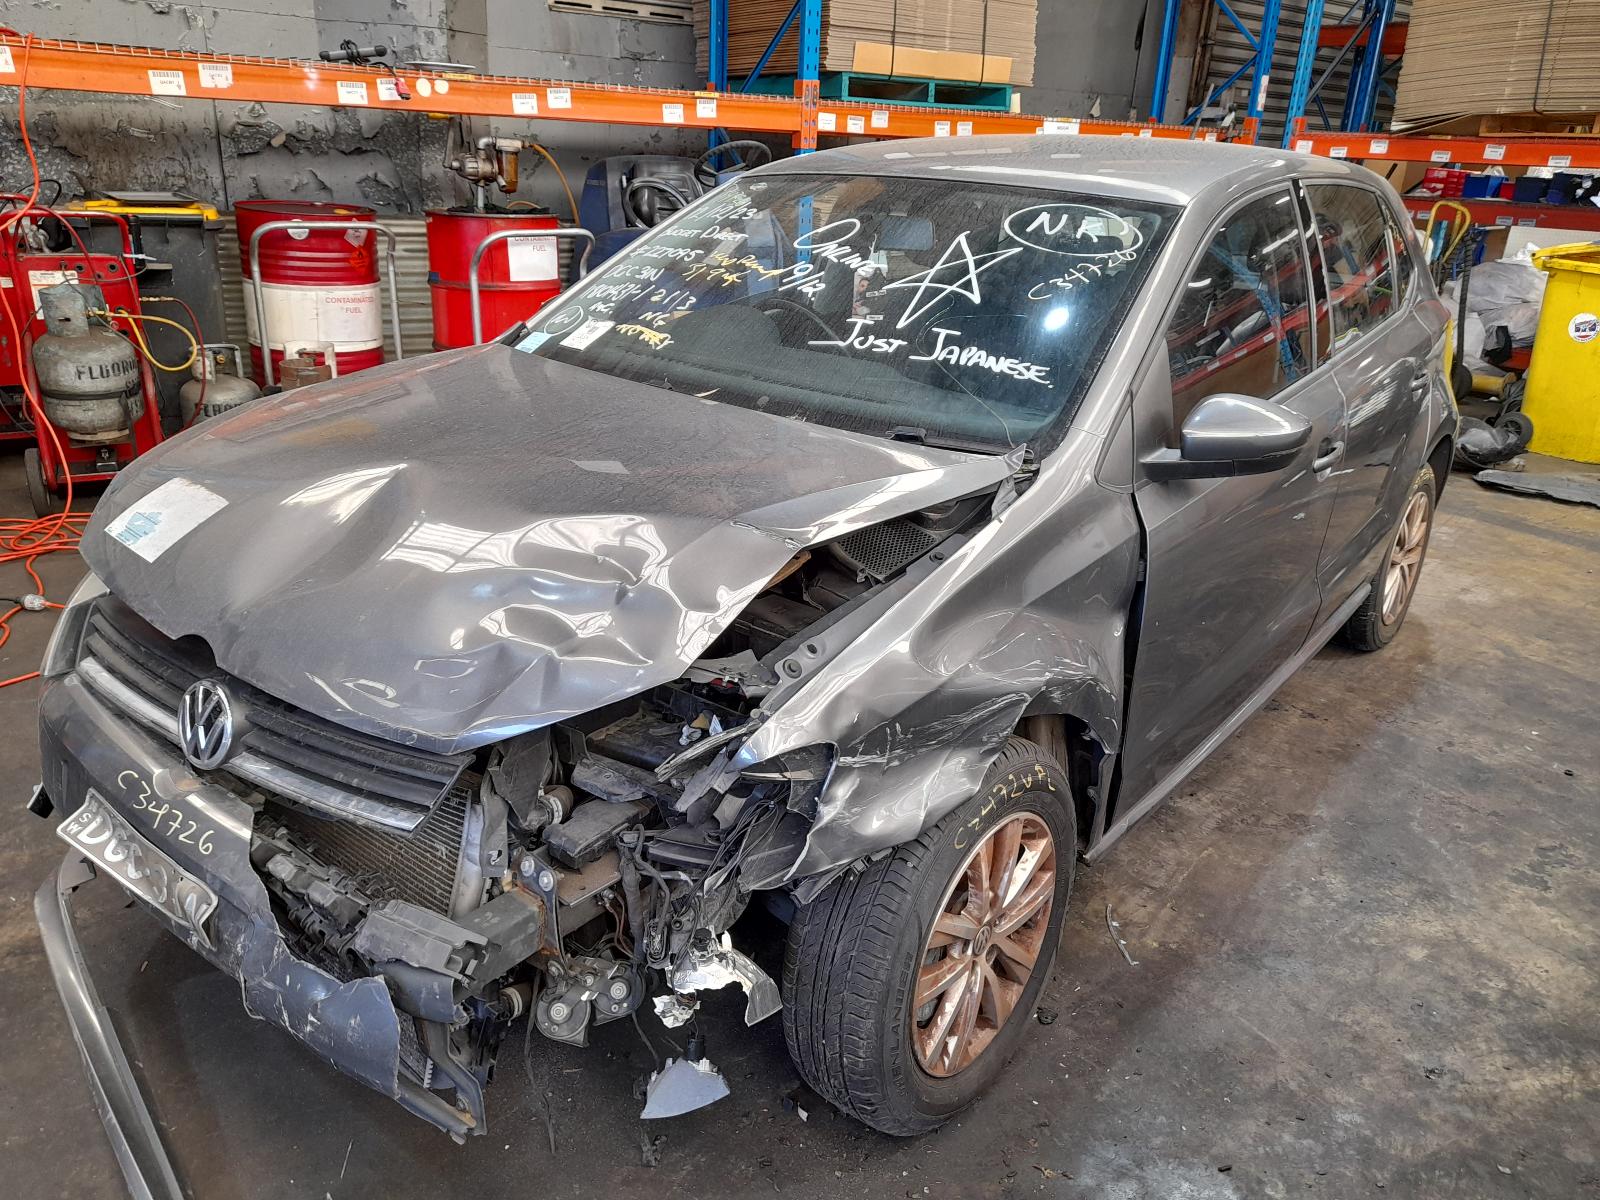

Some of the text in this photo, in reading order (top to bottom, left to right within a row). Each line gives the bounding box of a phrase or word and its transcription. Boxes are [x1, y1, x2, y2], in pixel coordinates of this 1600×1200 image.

[700, 225, 749, 242] DIRECT
[533, 244, 546, 252] FUEL
[345, 306, 362, 314] FUEL
[807, 318, 908, 352] JUST
[117, 769, 216, 855] C34726
